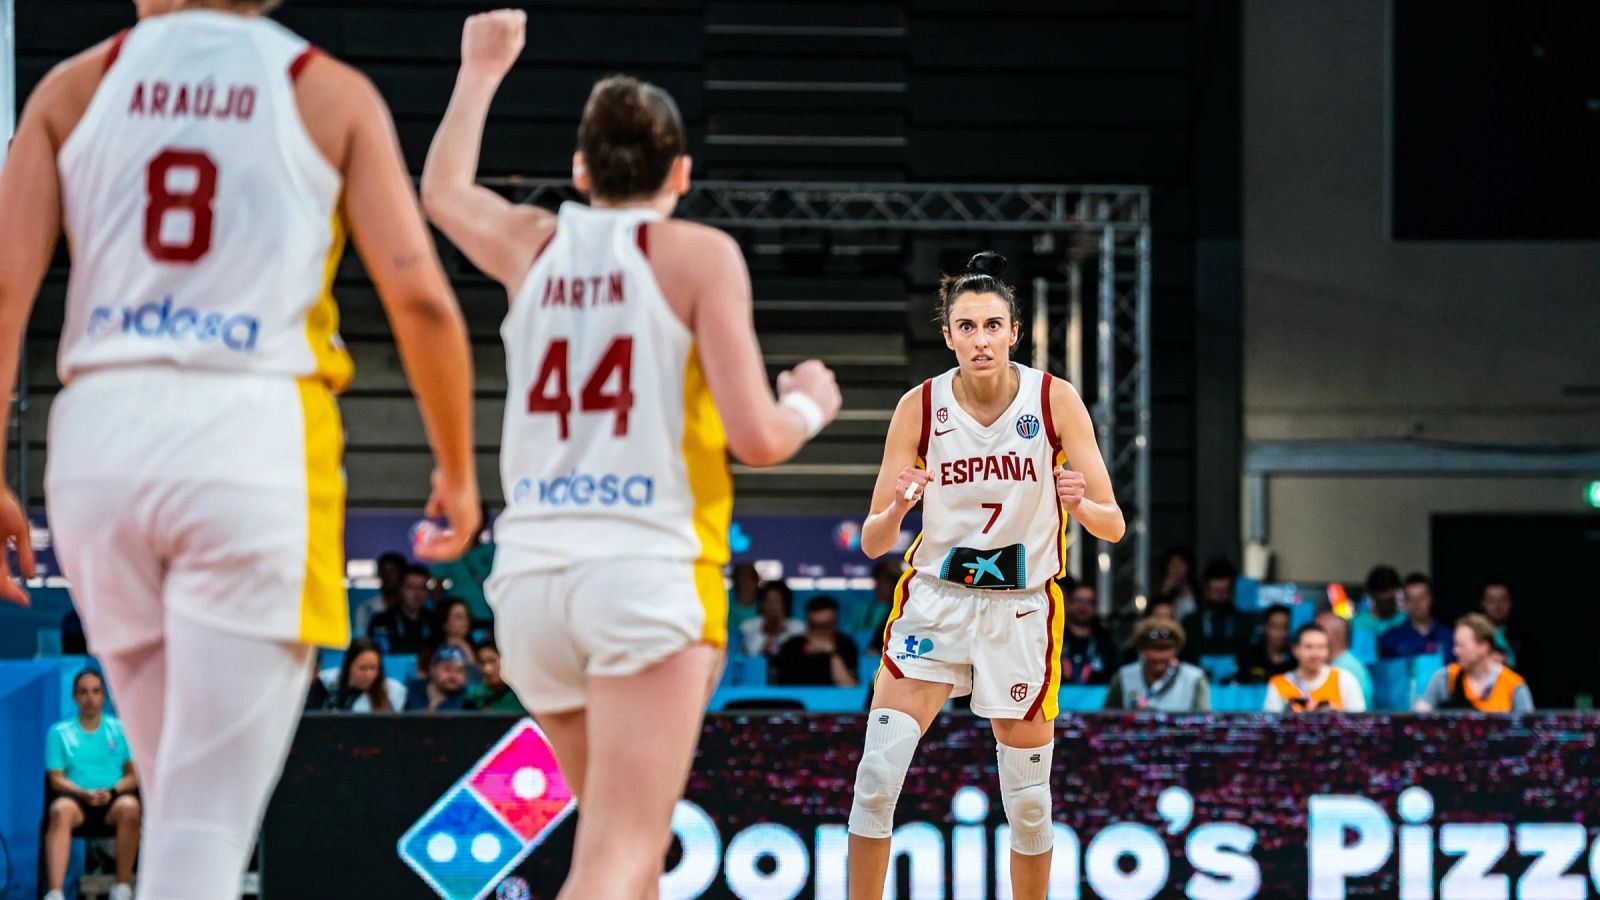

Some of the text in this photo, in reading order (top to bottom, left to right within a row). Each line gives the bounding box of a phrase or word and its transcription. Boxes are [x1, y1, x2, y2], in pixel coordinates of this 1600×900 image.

[128, 76, 257, 121] ARAÚJO
[143, 146, 219, 267] 8
[541, 271, 625, 309] ARTN
[526, 334, 636, 441] 44
[940, 451, 1038, 486] ESPAÑA
[981, 502, 1003, 535] 7
[1307, 786, 1600, 900] Pizz
